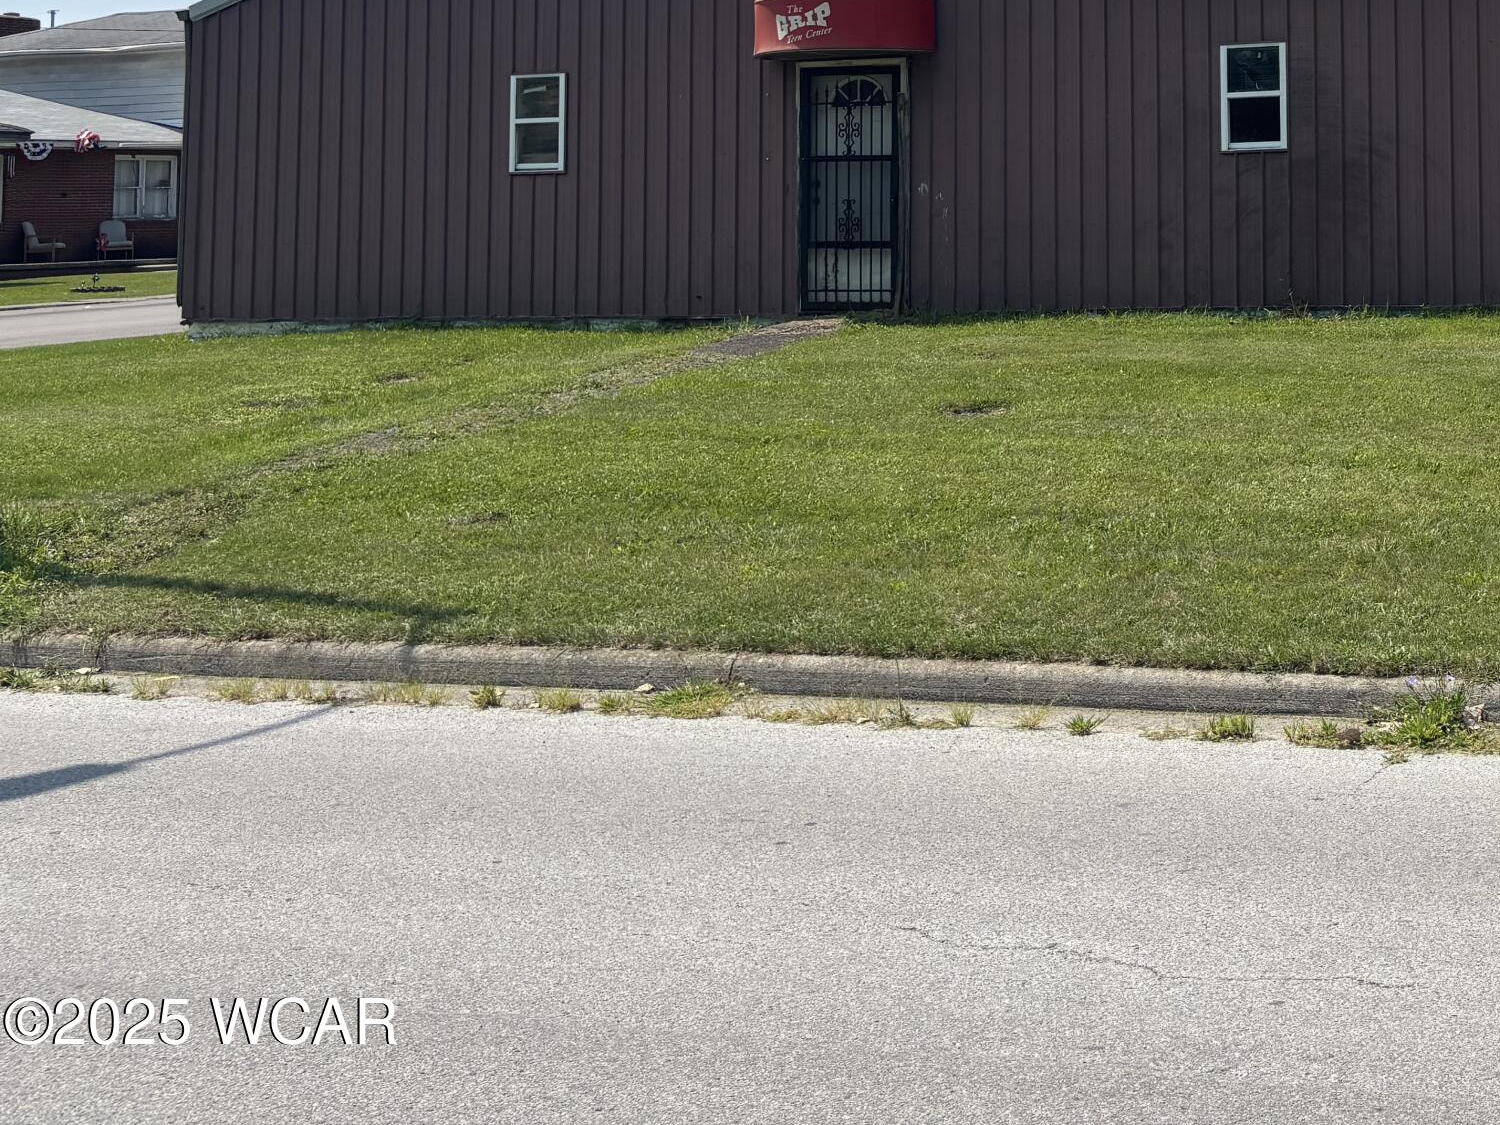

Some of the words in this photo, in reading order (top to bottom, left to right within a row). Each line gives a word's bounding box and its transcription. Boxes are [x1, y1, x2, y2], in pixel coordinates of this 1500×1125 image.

[786, 4, 803, 14] The
[775, 1, 831, 41] GRIP
[805, 27, 832, 39] Center
